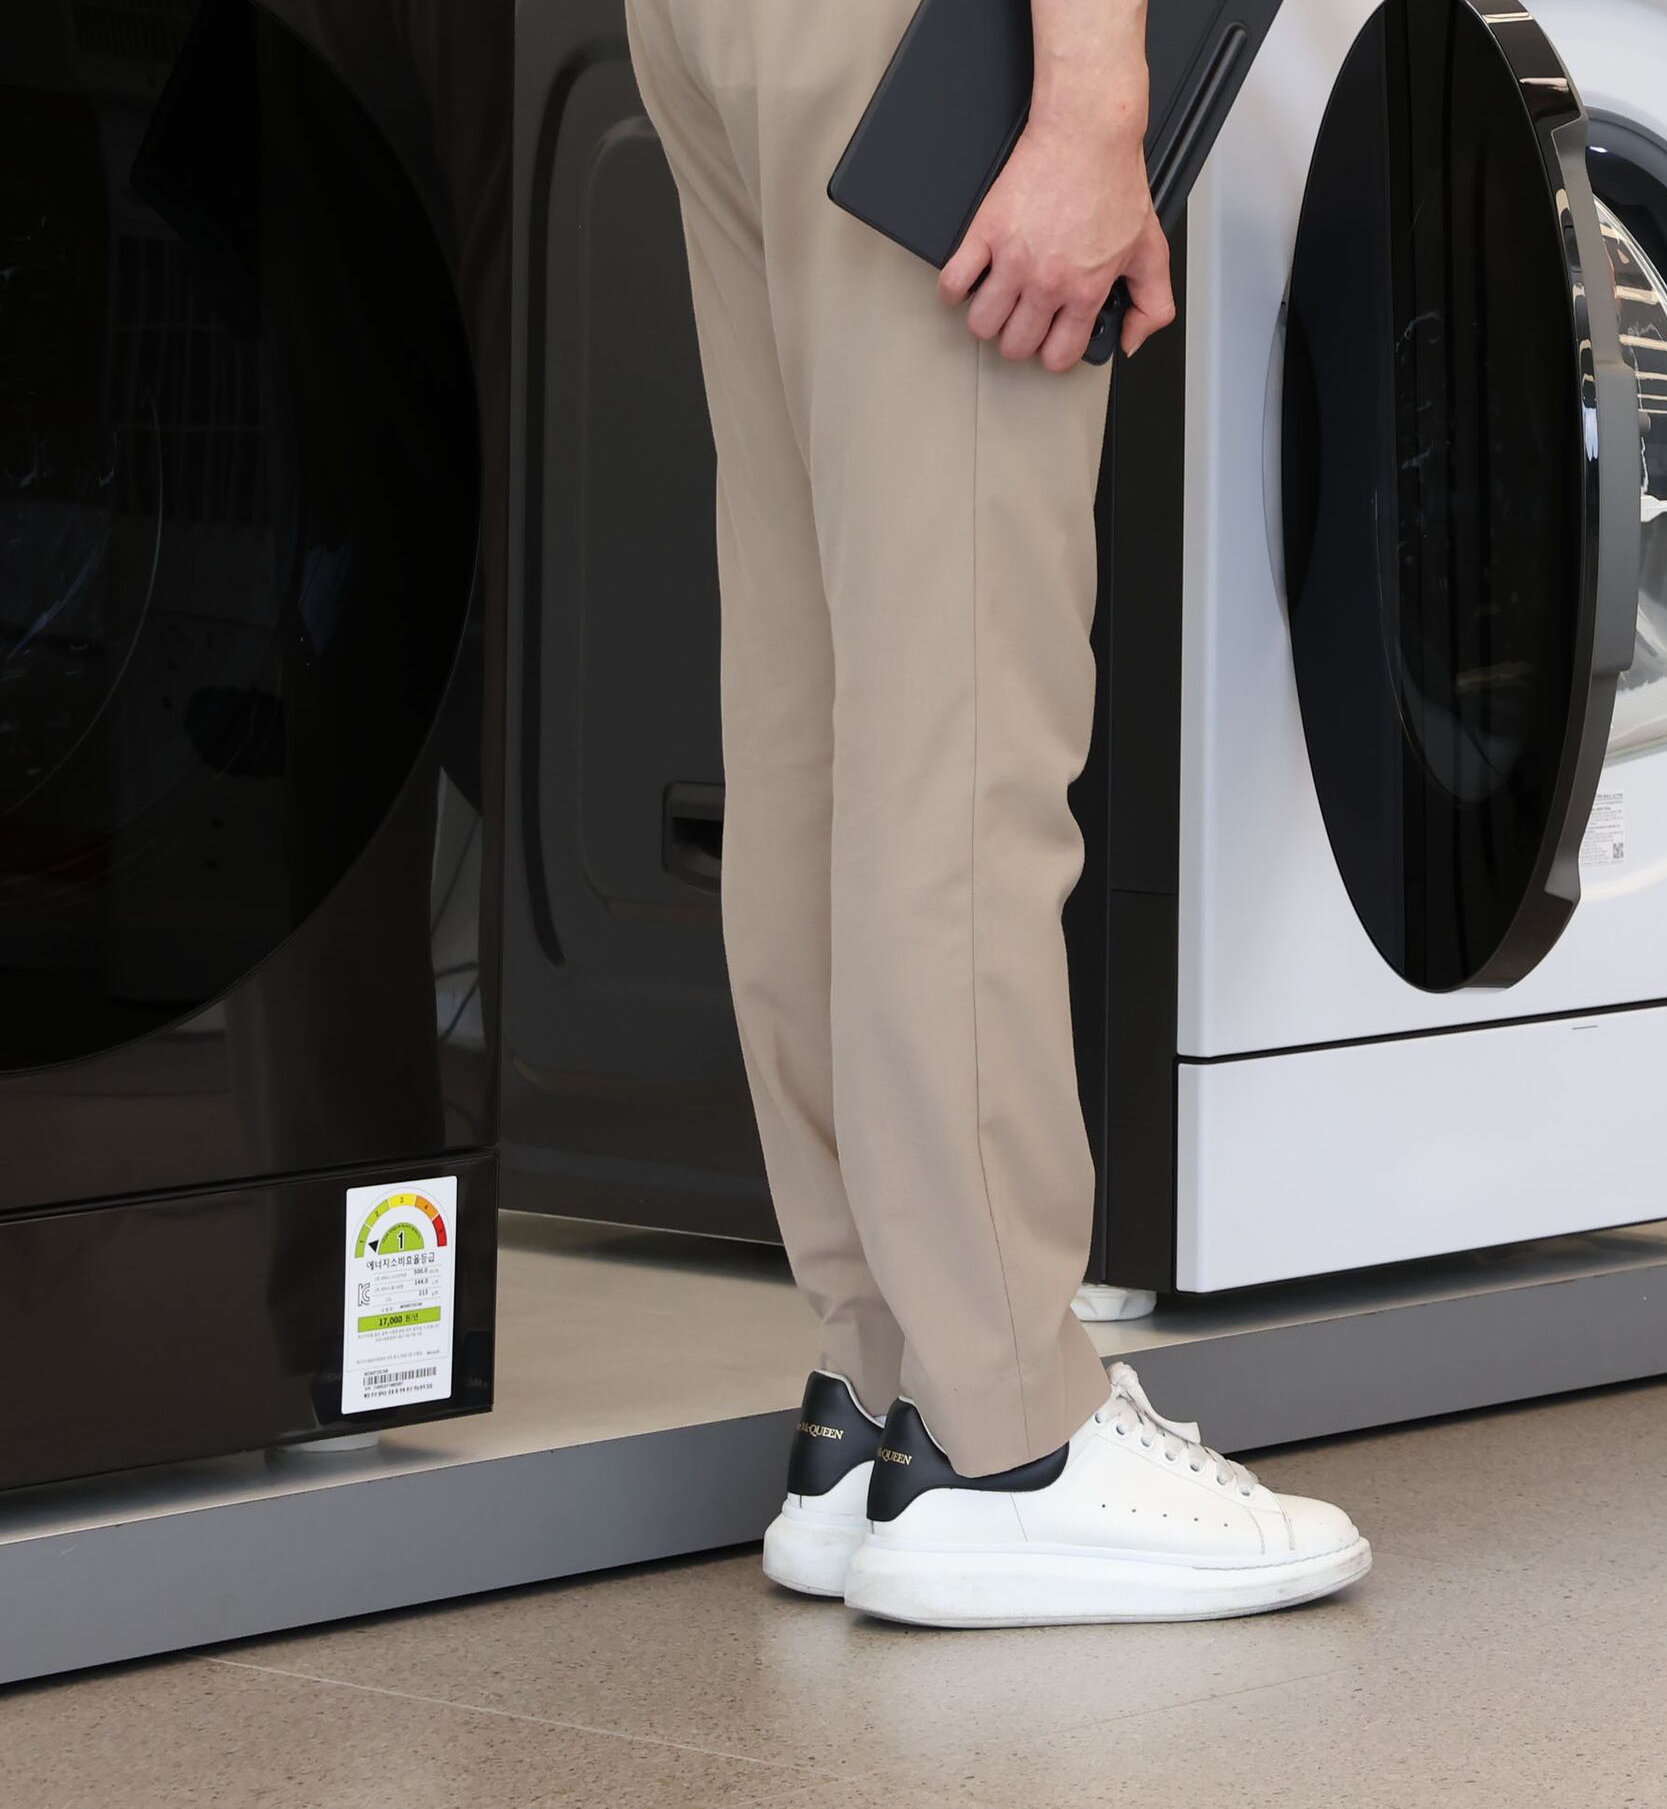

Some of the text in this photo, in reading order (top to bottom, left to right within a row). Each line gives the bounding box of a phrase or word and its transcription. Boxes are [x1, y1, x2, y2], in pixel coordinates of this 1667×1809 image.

[397, 1231, 404, 1250] 1
[366, 1252, 436, 1271] 에너지소비효율등급
[378, 1315, 403, 1327] 17,000
